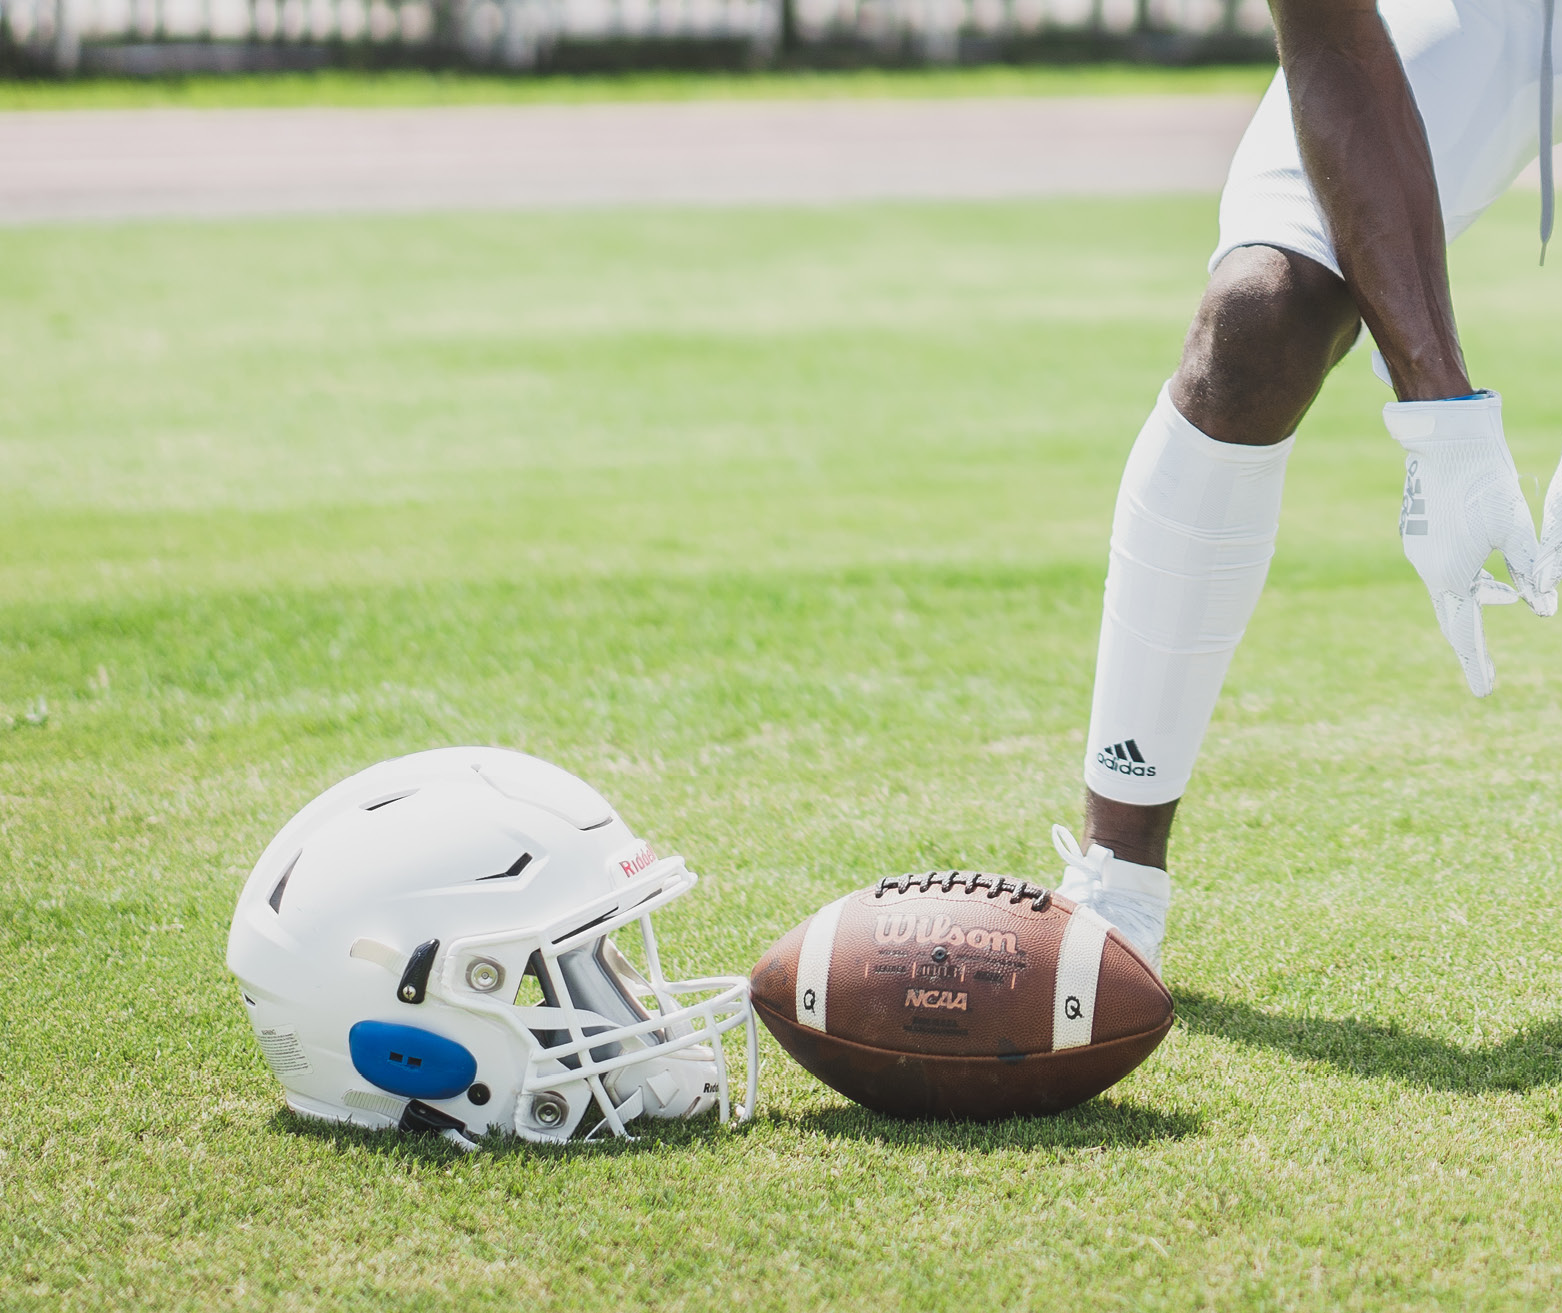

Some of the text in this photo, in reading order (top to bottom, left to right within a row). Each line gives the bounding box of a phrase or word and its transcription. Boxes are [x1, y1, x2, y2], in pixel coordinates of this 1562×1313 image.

[1097, 752, 1157, 777] adidas
[874, 913, 1018, 954] Wilson
[803, 988, 816, 1016] Q
[904, 987, 969, 1012] NCAA
[1065, 995, 1085, 1021] Q
[703, 1082, 720, 1094] Ridd
